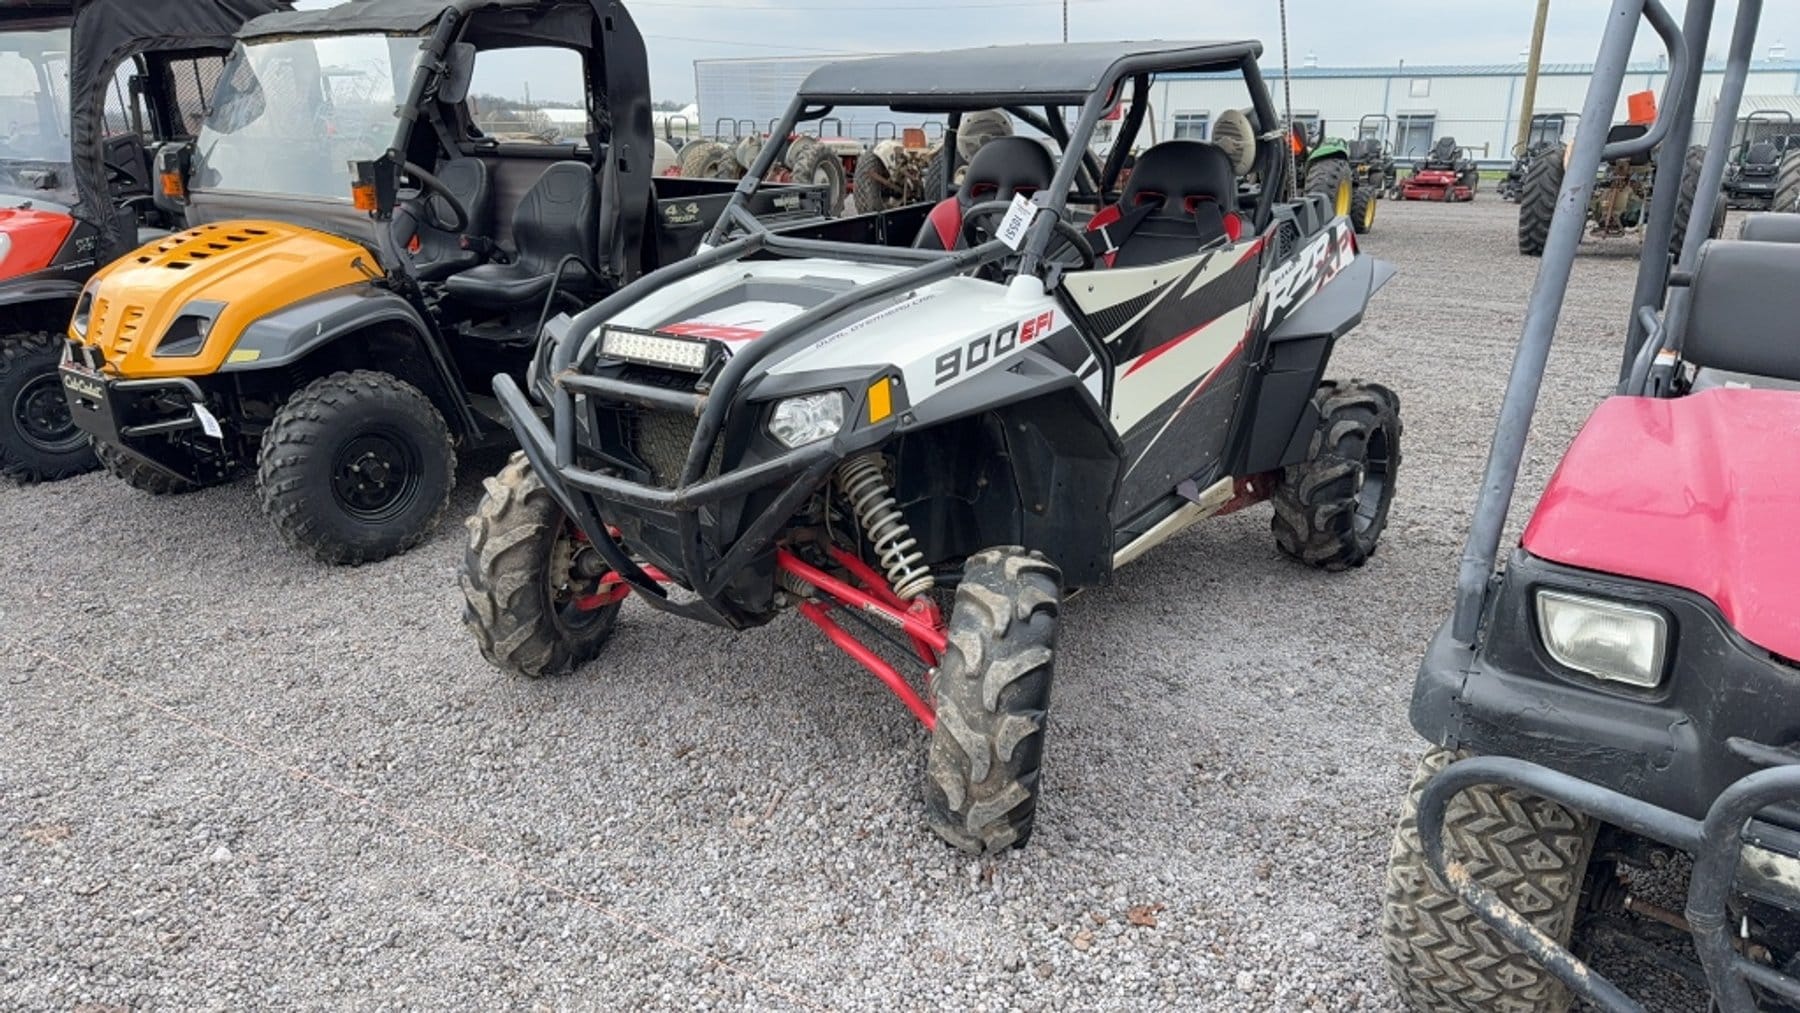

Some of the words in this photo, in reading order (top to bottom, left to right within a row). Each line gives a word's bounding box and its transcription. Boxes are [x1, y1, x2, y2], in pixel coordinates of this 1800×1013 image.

[1263, 231, 1330, 331] RZR
[935, 321, 1018, 386] 900
[1019, 309, 1054, 344] EFI
